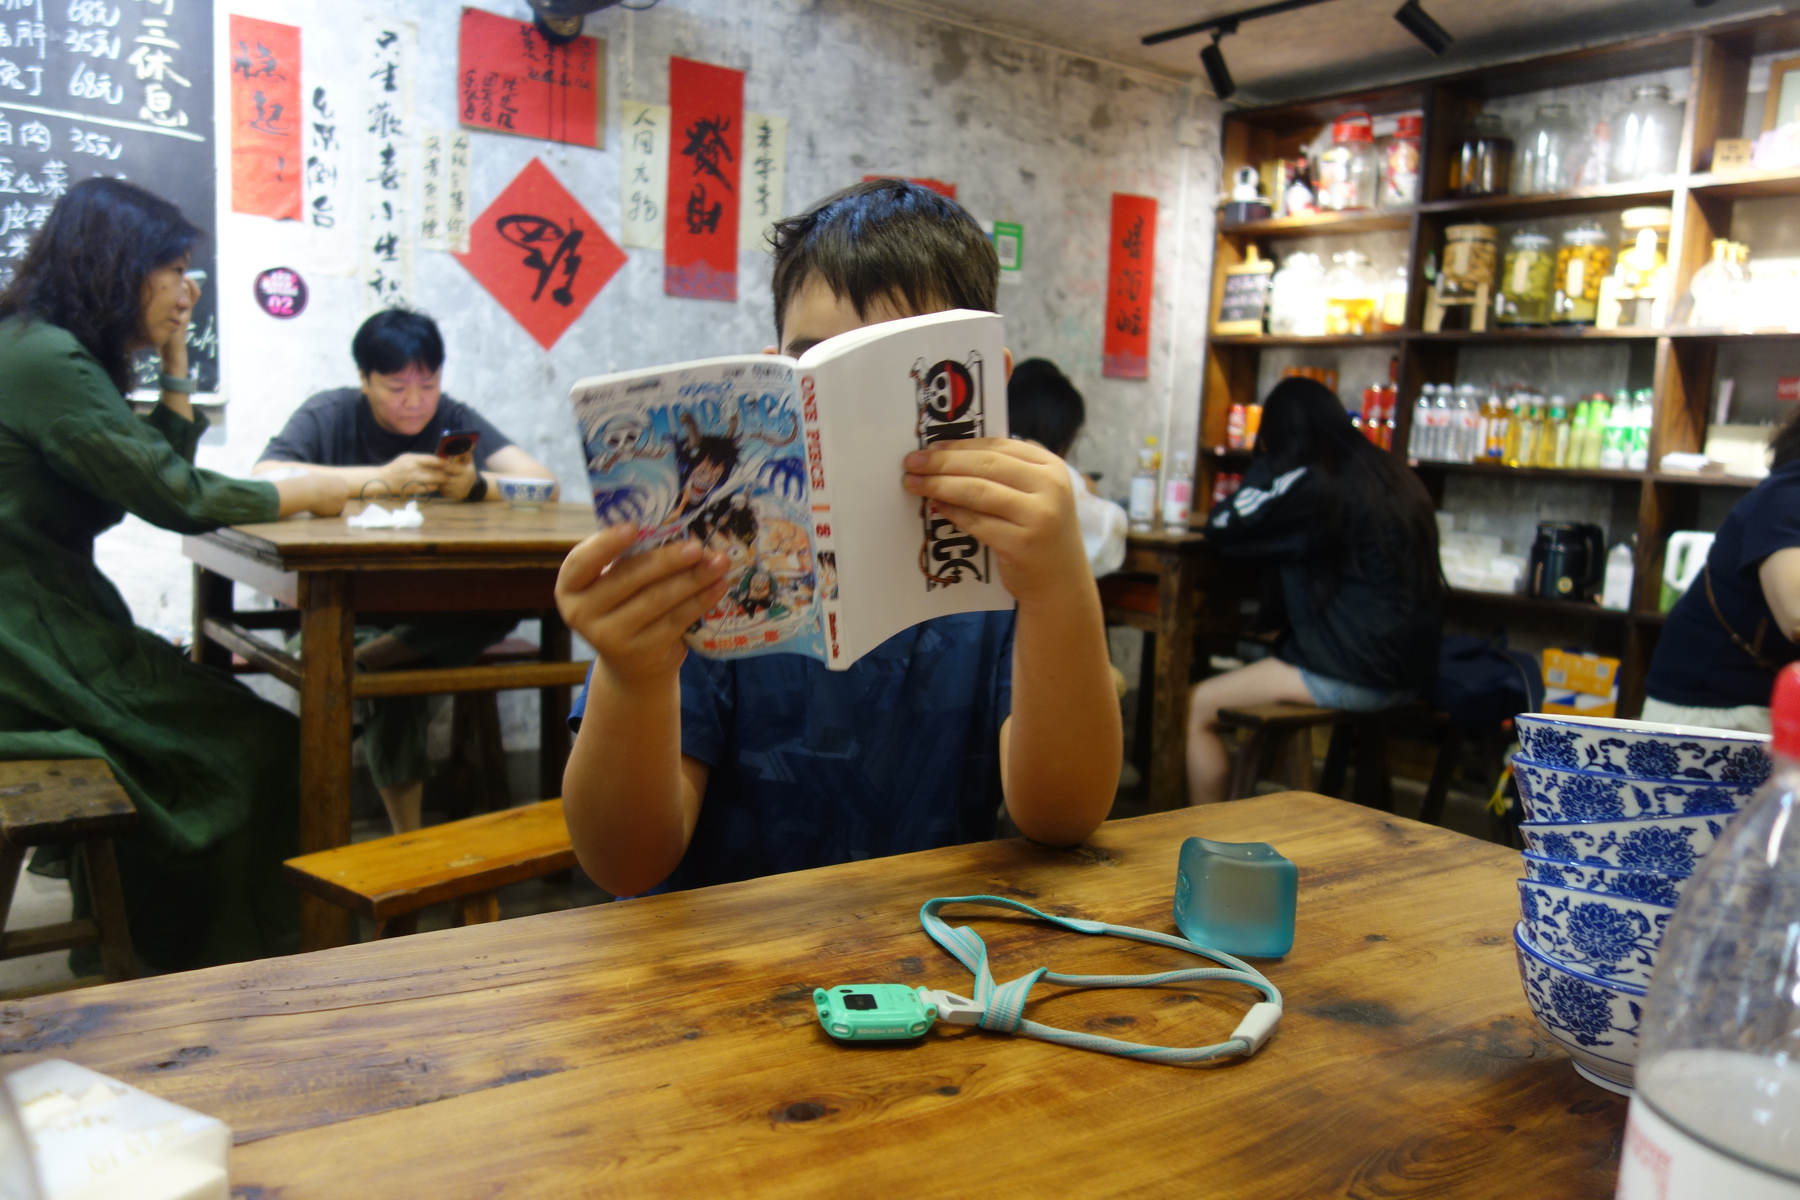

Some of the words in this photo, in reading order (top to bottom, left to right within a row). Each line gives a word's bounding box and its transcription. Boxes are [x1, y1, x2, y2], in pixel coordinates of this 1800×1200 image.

[268, 294, 294, 315] 02
[800, 375, 819, 423] ONE
[806, 427, 826, 491] PIECE
